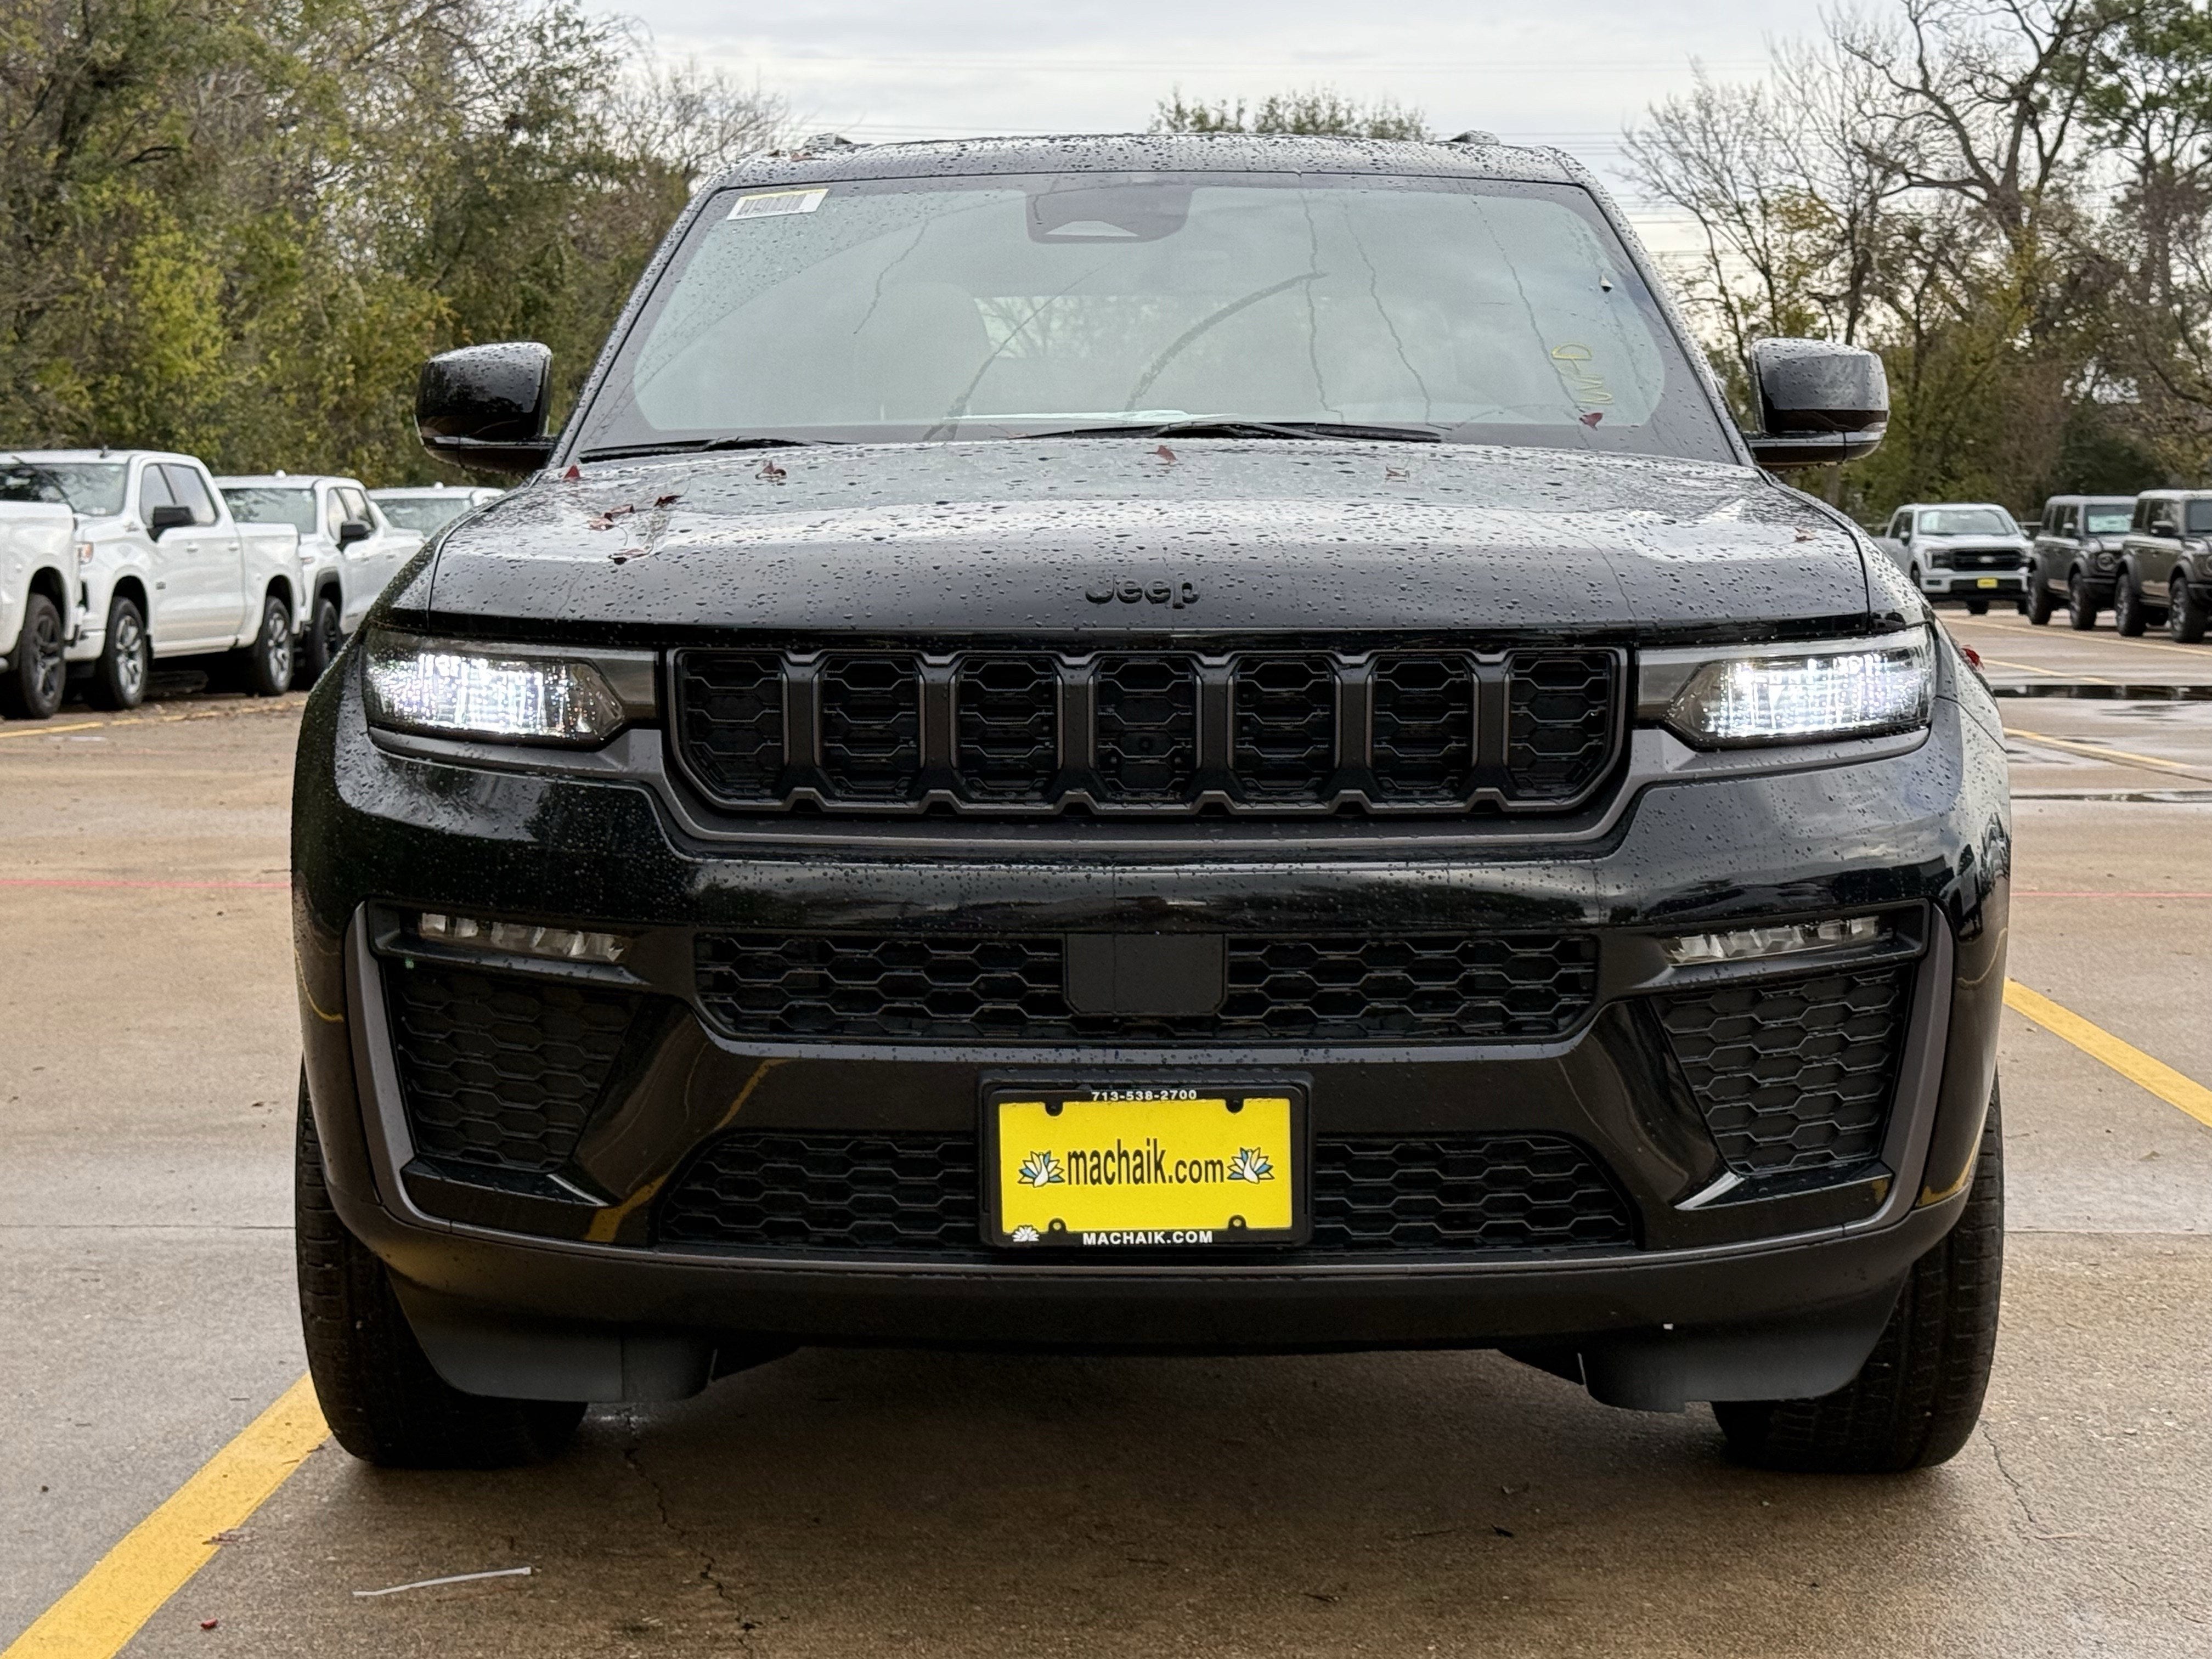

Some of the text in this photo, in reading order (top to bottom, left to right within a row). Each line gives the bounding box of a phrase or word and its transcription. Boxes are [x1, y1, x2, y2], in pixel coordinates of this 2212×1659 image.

[1085, 578, 1200, 610] Jeep
[1091, 1090, 1198, 1102] 713-538-2700
[1067, 1138, 1224, 1186] machaik.com
[1082, 1231, 1213, 1245] MACHAIK.COM
